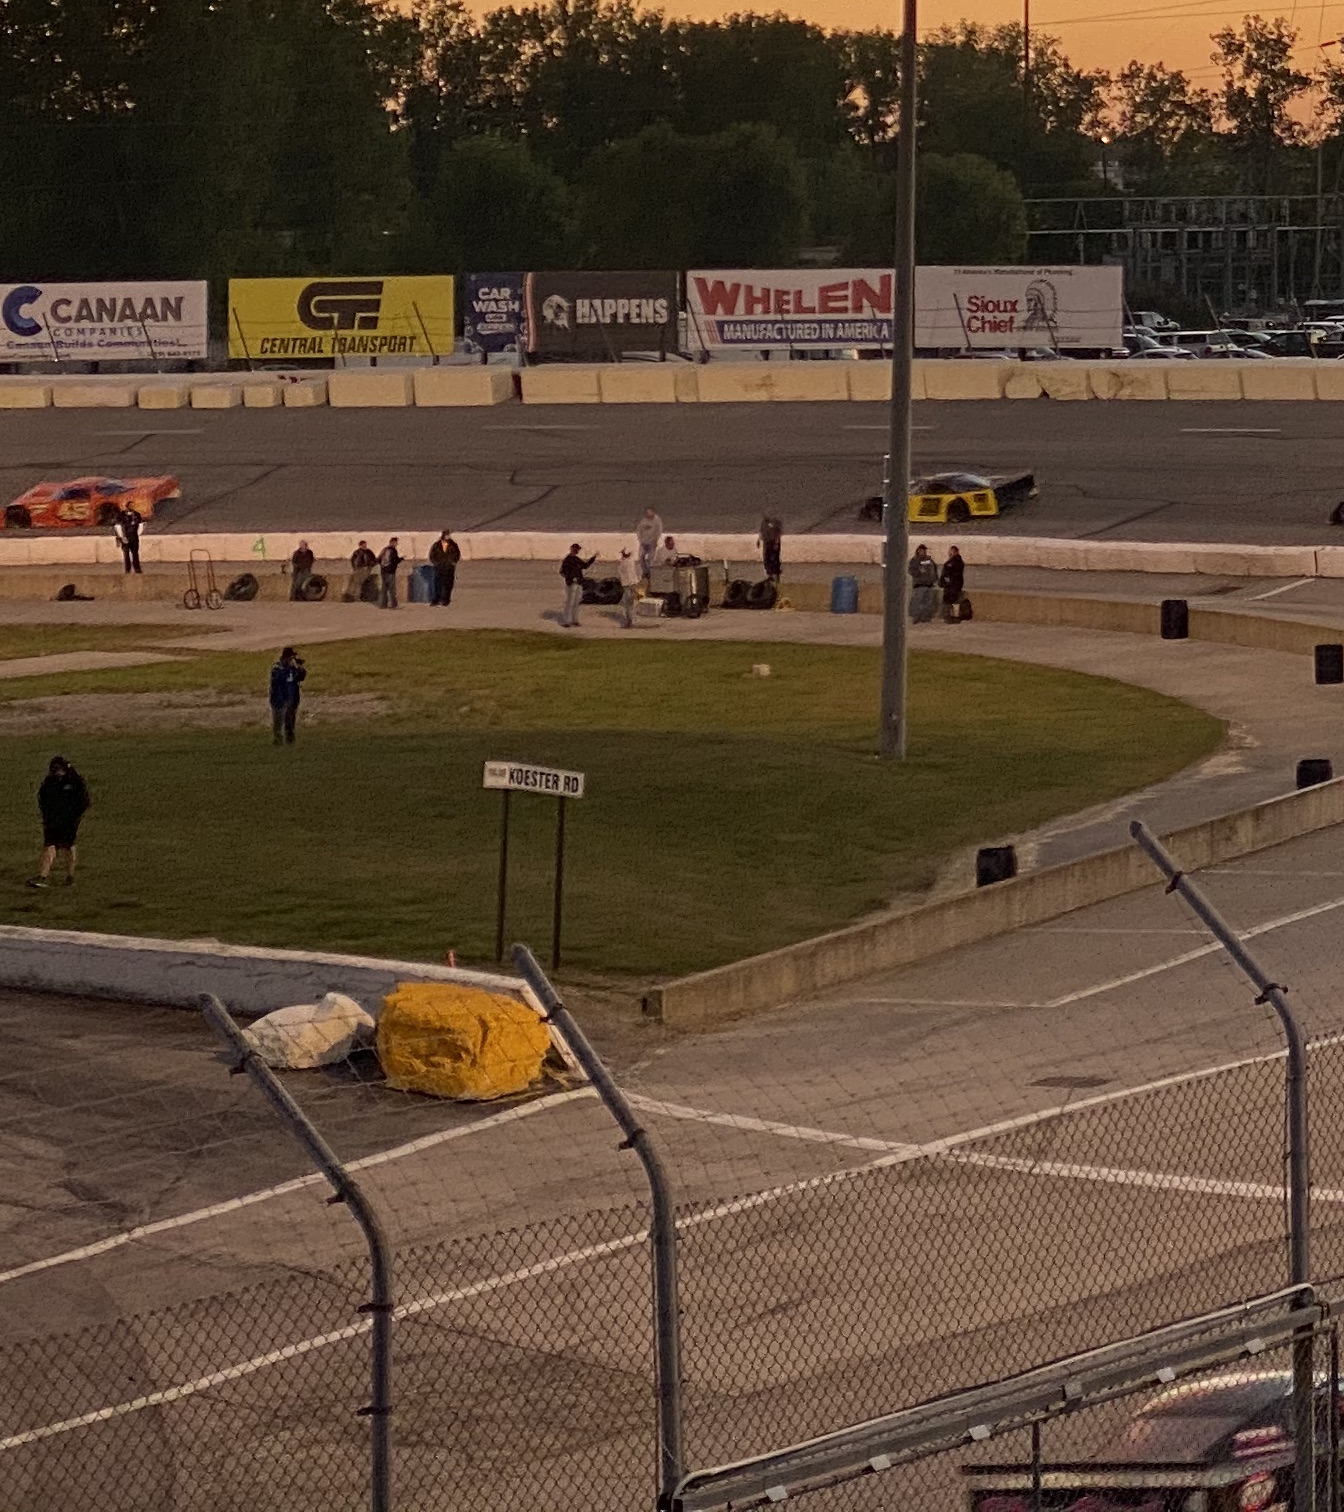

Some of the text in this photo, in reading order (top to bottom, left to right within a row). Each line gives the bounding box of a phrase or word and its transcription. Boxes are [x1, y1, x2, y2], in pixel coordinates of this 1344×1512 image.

[478, 287, 511, 300] CAR
[693, 273, 892, 316] WHELEN
[50, 296, 184, 324] CANAAN
[472, 300, 520, 313] WASH
[575, 298, 668, 324] HAPPENS
[966, 295, 1018, 313] Sioux
[53, 327, 143, 337] COMPANIES
[723, 322, 889, 340] MANUFACTURED IN AMERICA
[966, 316, 1015, 333] Chief
[260, 335, 416, 354] CENTRAL TRANSPORT
[508, 768, 560, 790] KOESTER
[563, 775, 579, 793] RD
